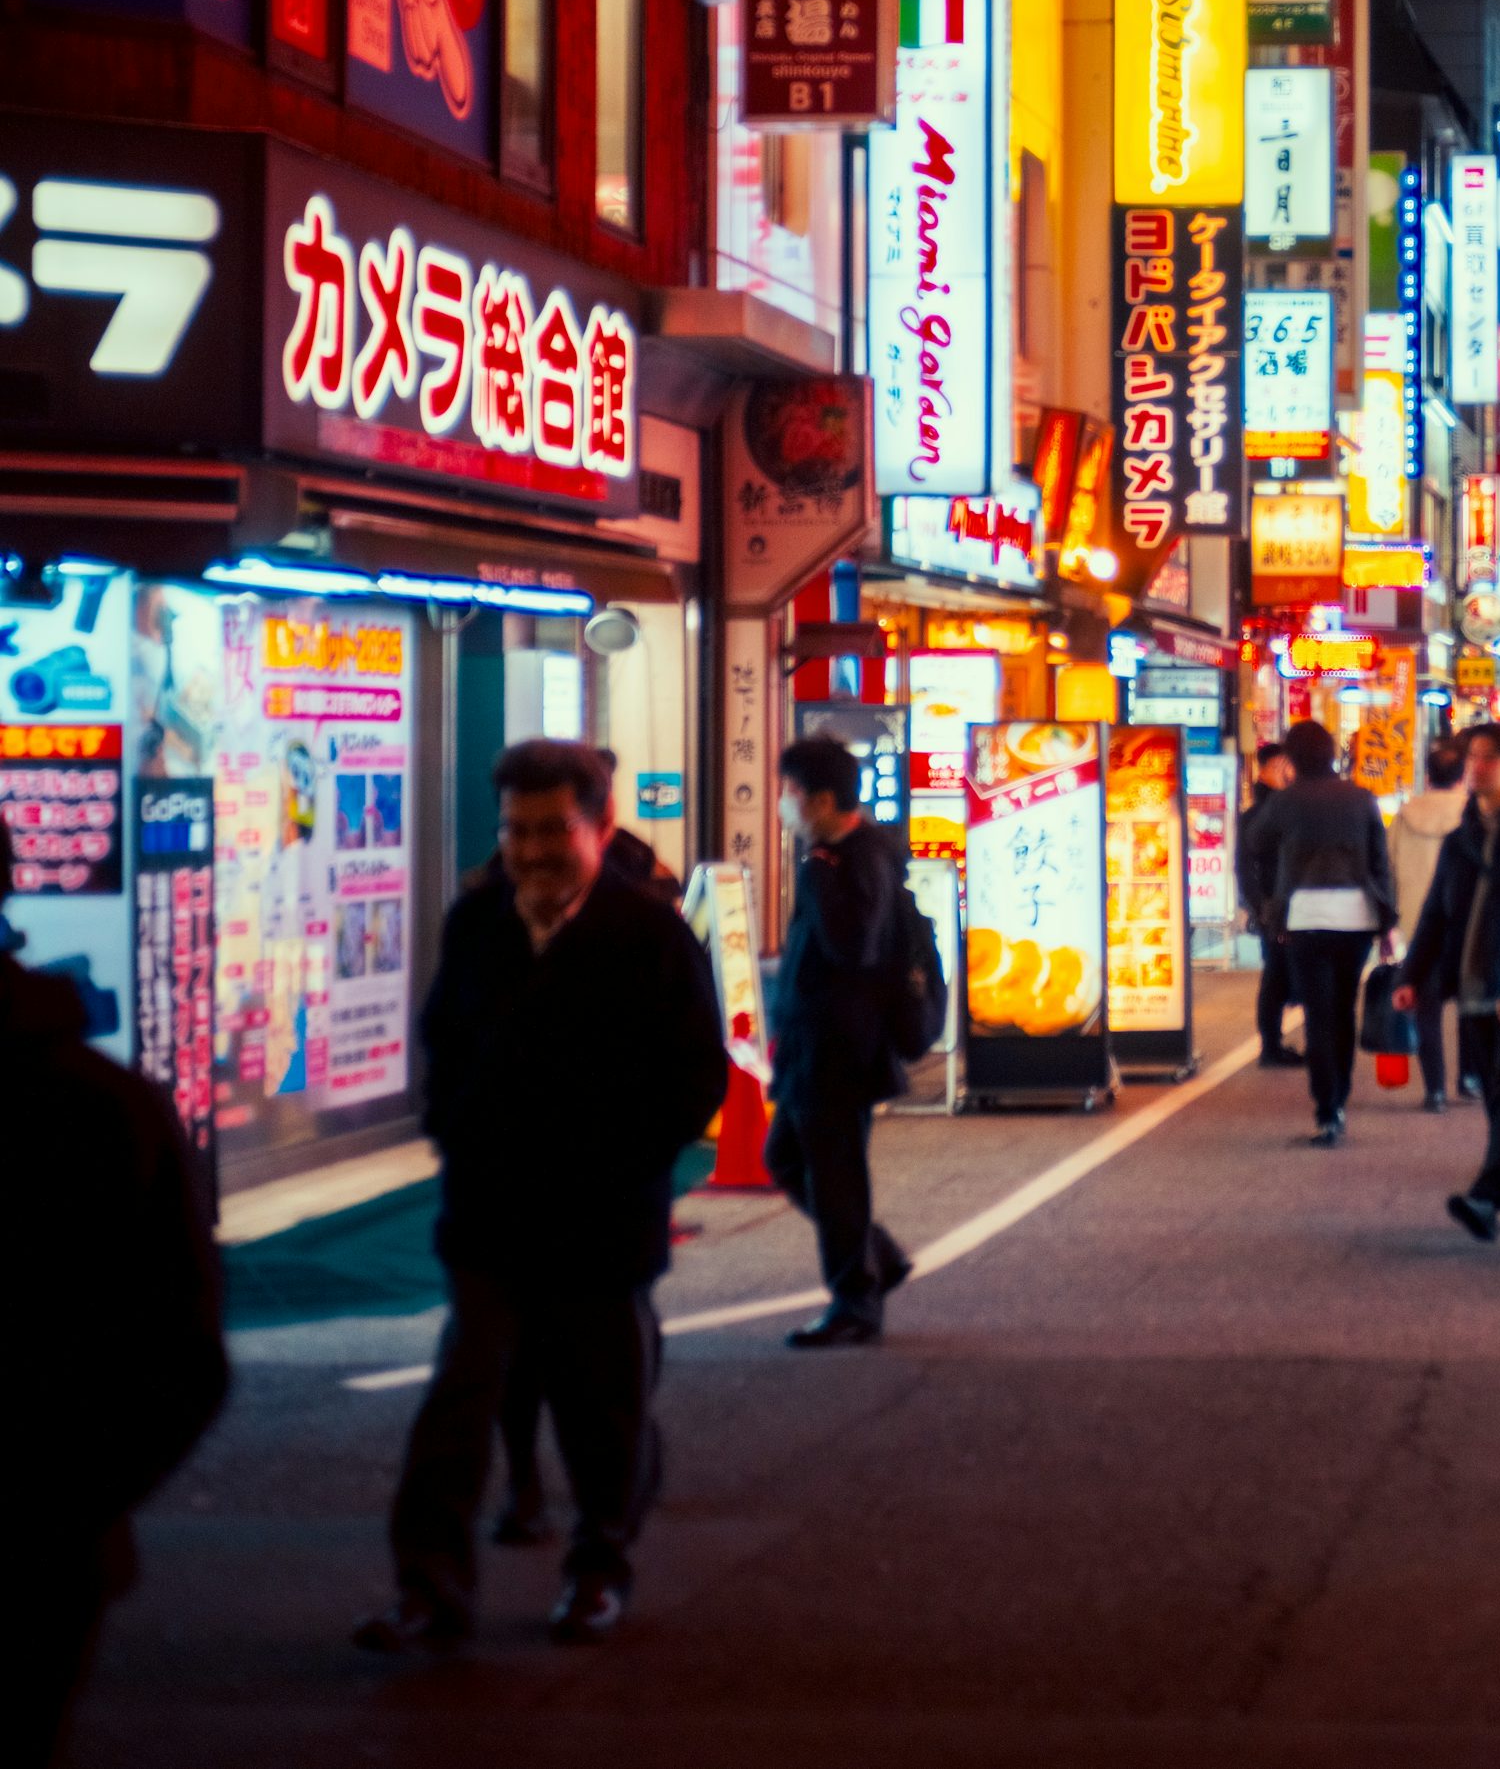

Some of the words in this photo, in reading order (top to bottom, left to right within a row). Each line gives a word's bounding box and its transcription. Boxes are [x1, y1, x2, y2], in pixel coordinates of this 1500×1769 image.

[911, 116, 956, 301] Miami
[282, 194, 638, 479] カメラ総合館
[1122, 208, 1176, 551] ヨドバシカメラ
[1184, 211, 1229, 526] ケータイアクセサリー館
[1256, 349, 1309, 376] 酒場
[1464, 224, 1487, 389] 買取センター
[140, 793, 207, 822] GoPro
[1005, 824, 1060, 928] 餃子
